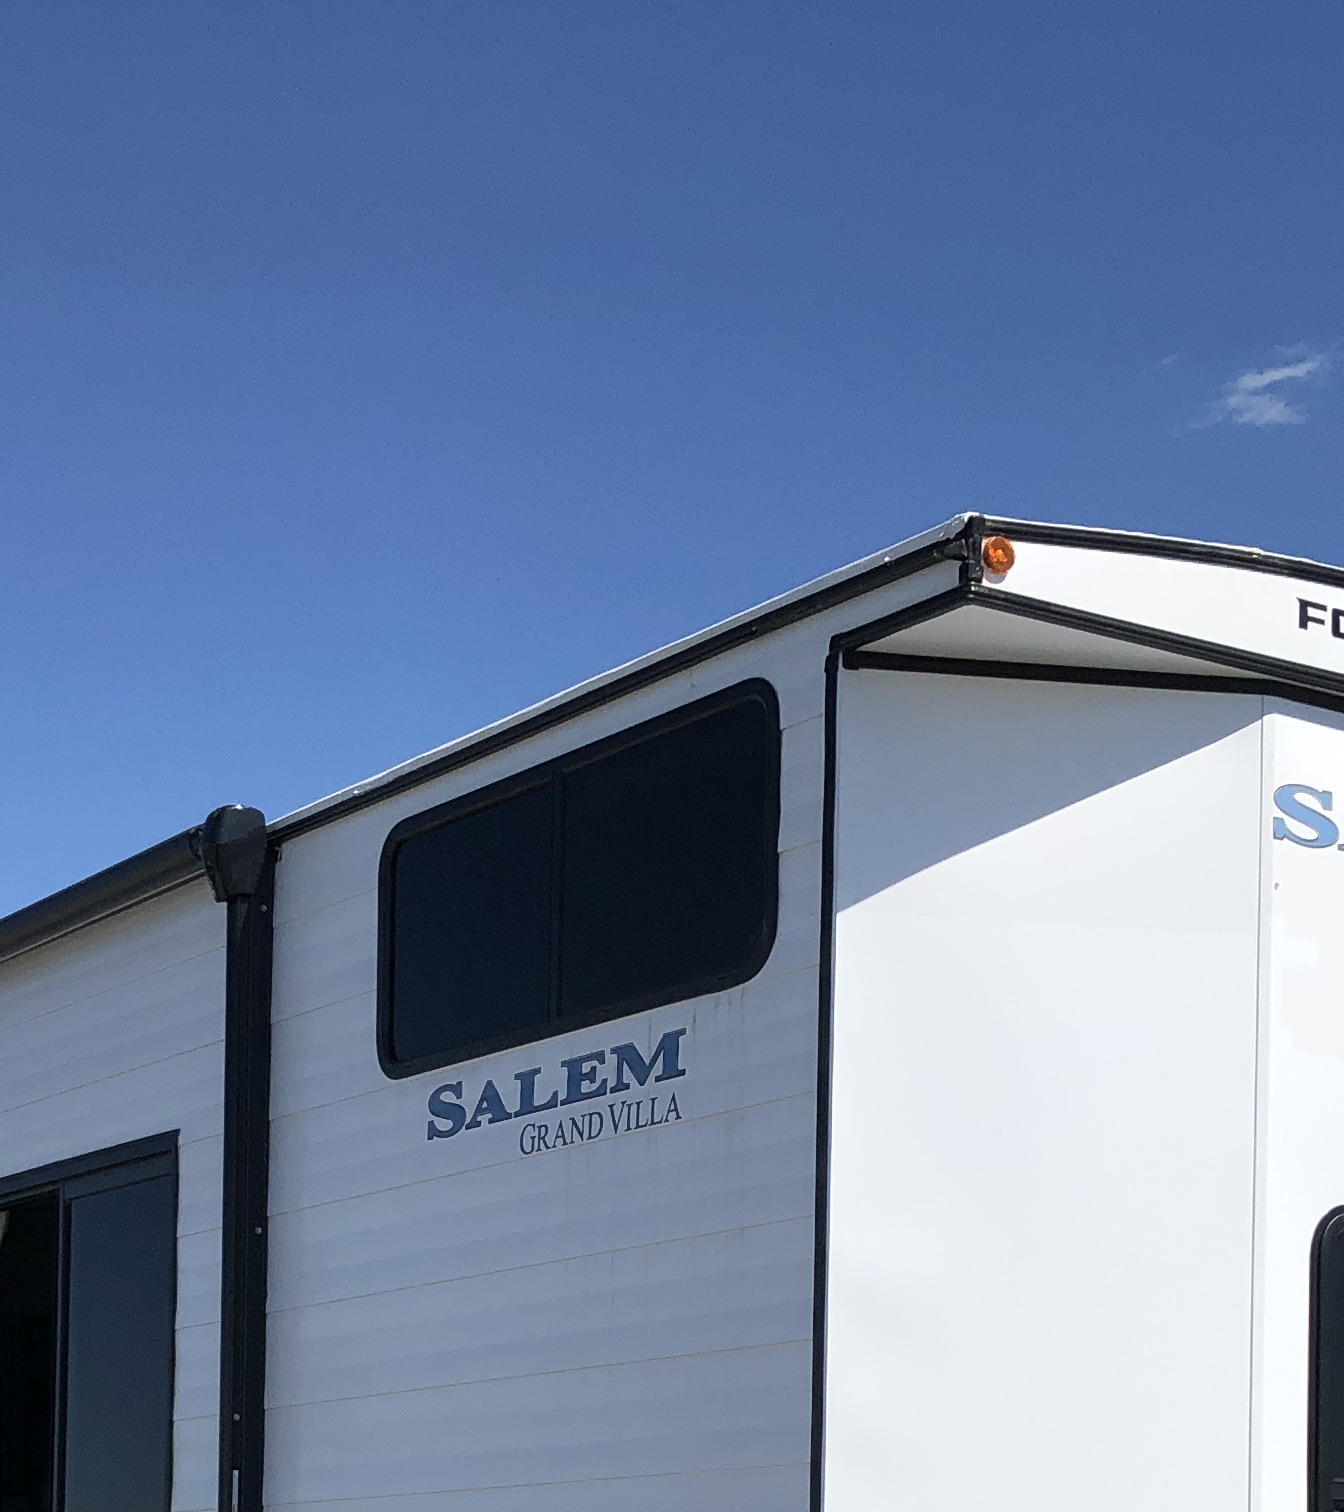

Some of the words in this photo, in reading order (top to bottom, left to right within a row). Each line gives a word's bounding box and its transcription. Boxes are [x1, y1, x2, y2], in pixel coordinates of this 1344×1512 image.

[426, 1027, 687, 1141] SALEM
[519, 1111, 604, 1156] GRAND
[607, 1092, 683, 1136] VILLA
